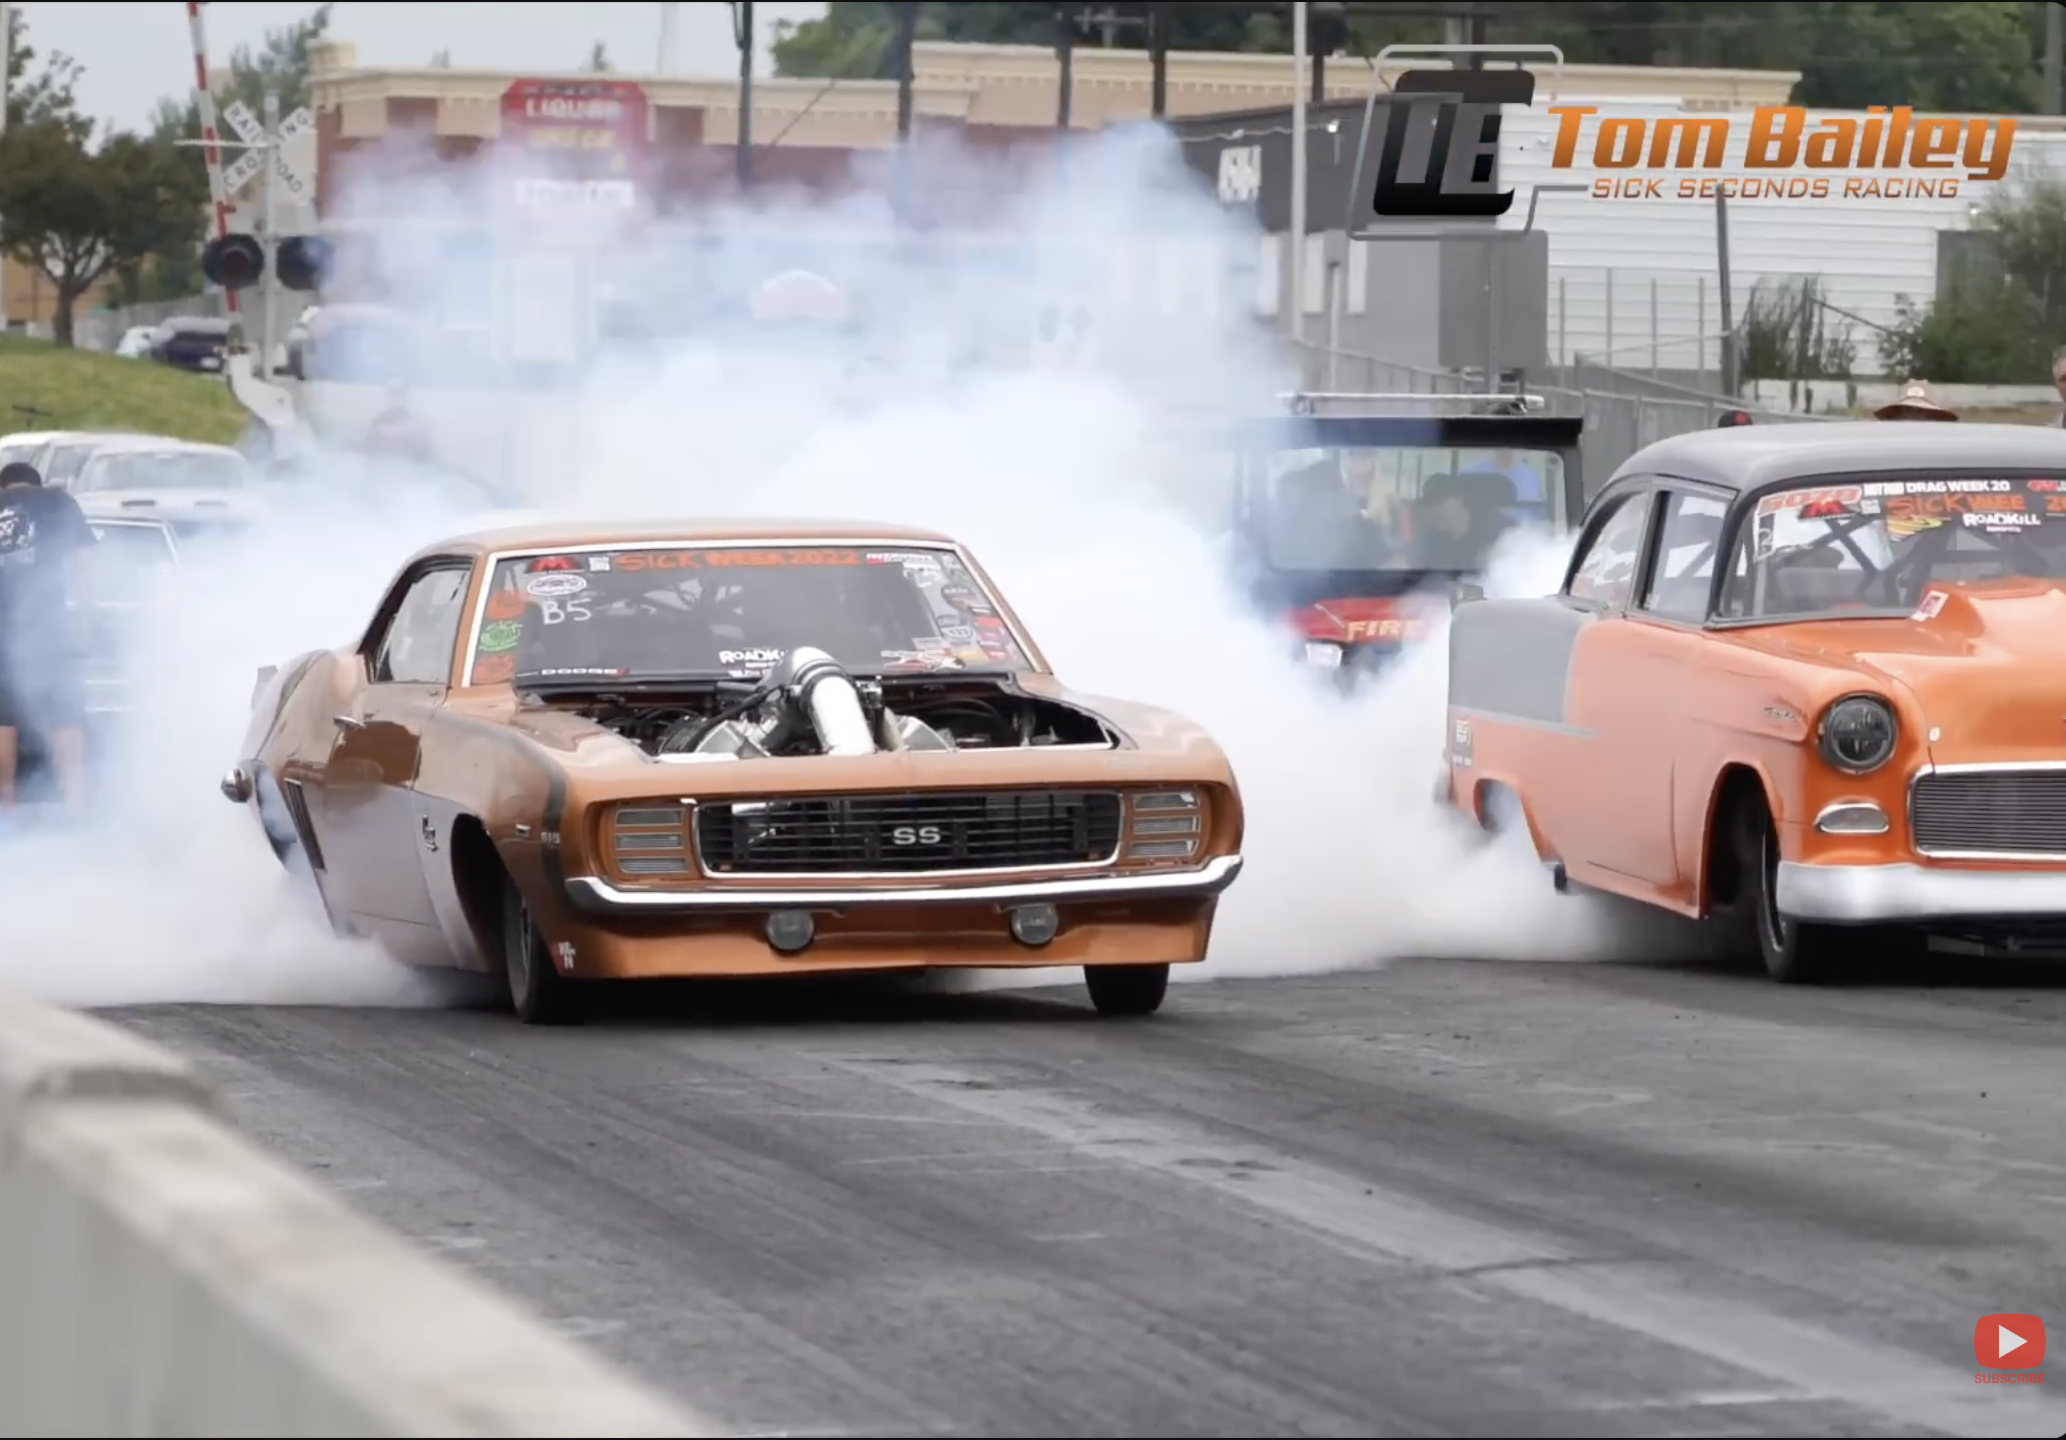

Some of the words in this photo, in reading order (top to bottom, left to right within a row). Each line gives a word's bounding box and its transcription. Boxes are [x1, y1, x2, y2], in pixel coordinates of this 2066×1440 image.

[1906, 482, 1946, 493] DRAG
[1947, 481, 1990, 492] WEEK
[614, 553, 702, 571] SICK
[542, 598, 592, 625] B5
[1348, 619, 1425, 641] FIRE
[893, 826, 941, 845] SS
